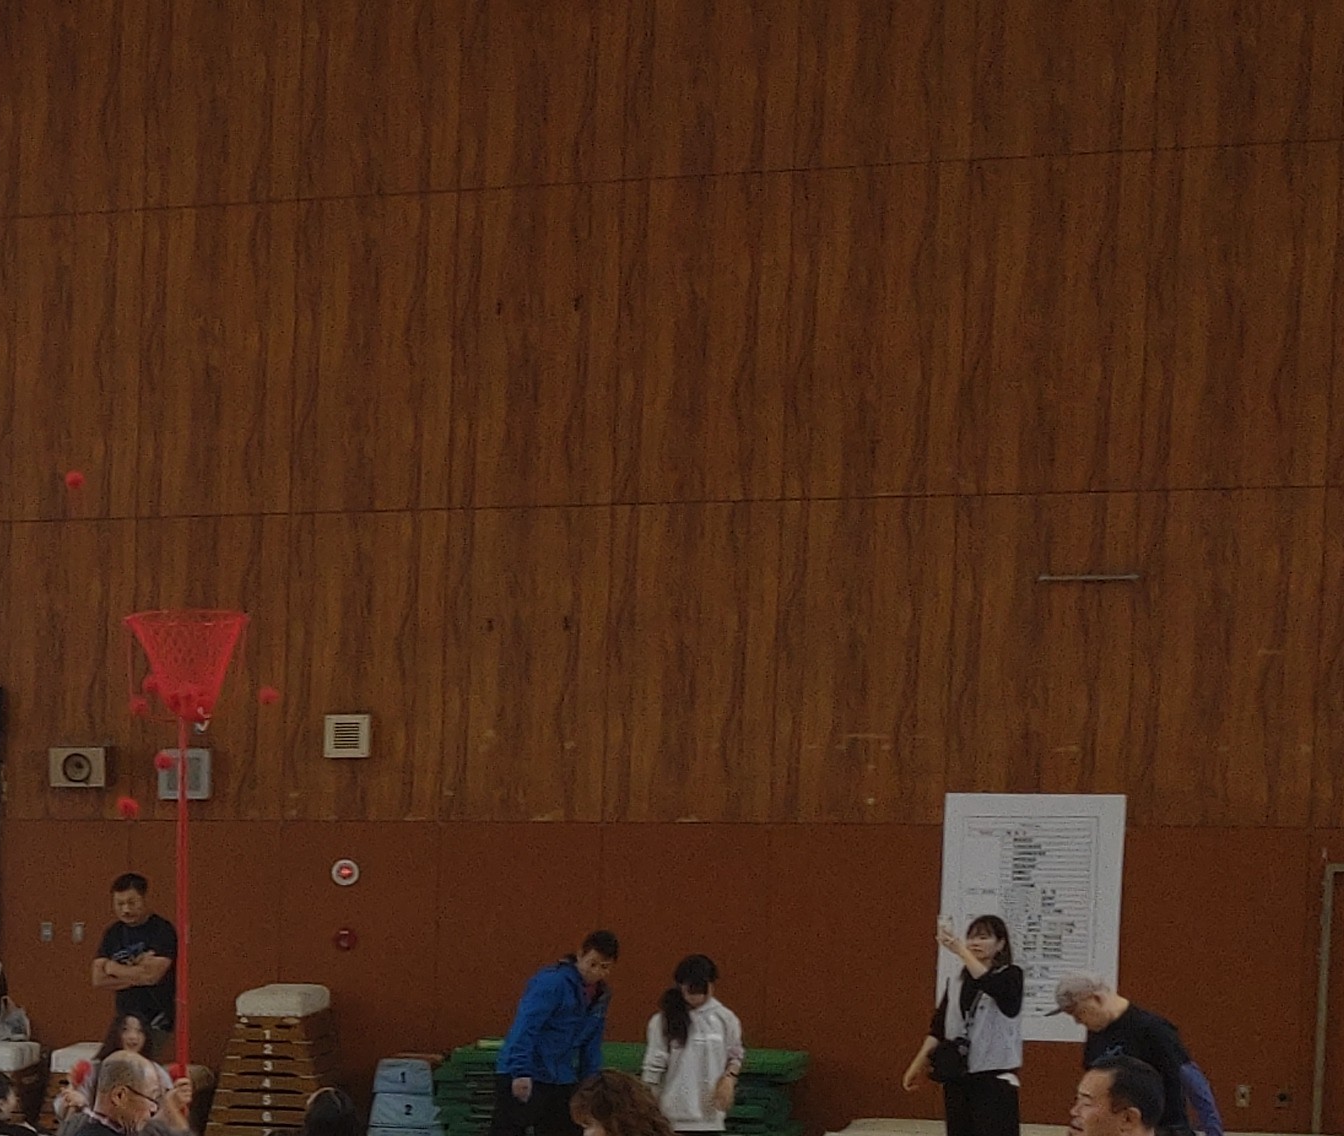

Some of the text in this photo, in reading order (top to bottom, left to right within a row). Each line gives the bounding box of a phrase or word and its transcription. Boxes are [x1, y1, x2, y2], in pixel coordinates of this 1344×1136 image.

[263, 1029, 271, 1040] 1
[262, 1044, 273, 1054] 2
[262, 1061, 273, 1071] 3
[400, 1071, 407, 1083] 1
[261, 1078, 271, 1088] 4
[262, 1095, 272, 1105] 5
[404, 1103, 413, 1115] 2
[261, 1111, 272, 1122] 6
